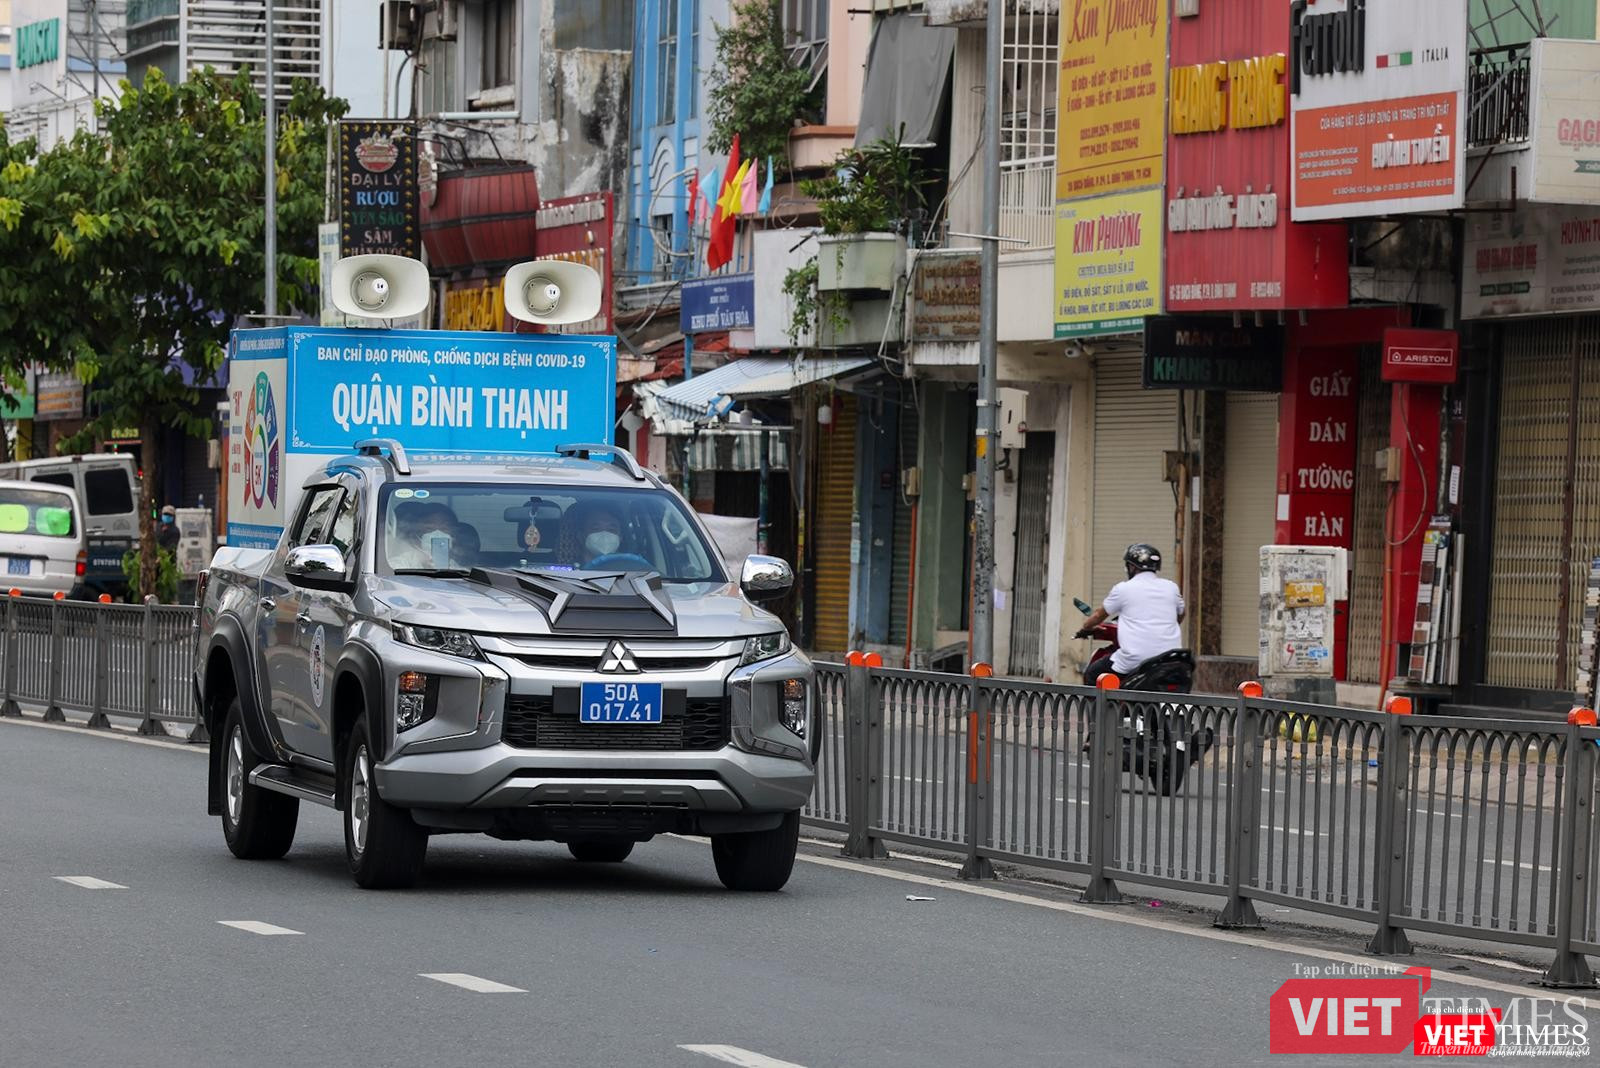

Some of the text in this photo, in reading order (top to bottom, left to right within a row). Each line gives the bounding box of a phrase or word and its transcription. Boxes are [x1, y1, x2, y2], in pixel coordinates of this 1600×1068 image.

[1290, 0, 1365, 96] ferroli
[1421, 47, 1449, 63] ITALIA
[356, 190, 400, 208] RƯỢU
[1072, 219, 1096, 254] KIM
[720, 309, 735, 326] VĂN
[735, 306, 749, 325] HÓA
[318, 342, 586, 370] BAN CHỈ ĐẠO PHÒNG, CHỐNG DỊCH BỆNH COVID-19
[1153, 356, 1212, 382] KHANG
[1405, 354, 1449, 363] ARISTON
[1310, 370, 1352, 397] GIẤY
[332, 373, 569, 439] QUẬN BÌNH THẠNH
[1309, 417, 1347, 442] DÁN
[1298, 462, 1353, 490] TƯỜNG
[1304, 511, 1344, 537] HÀN
[604, 684, 639, 702] 50A
[590, 703, 653, 721] 017.41
